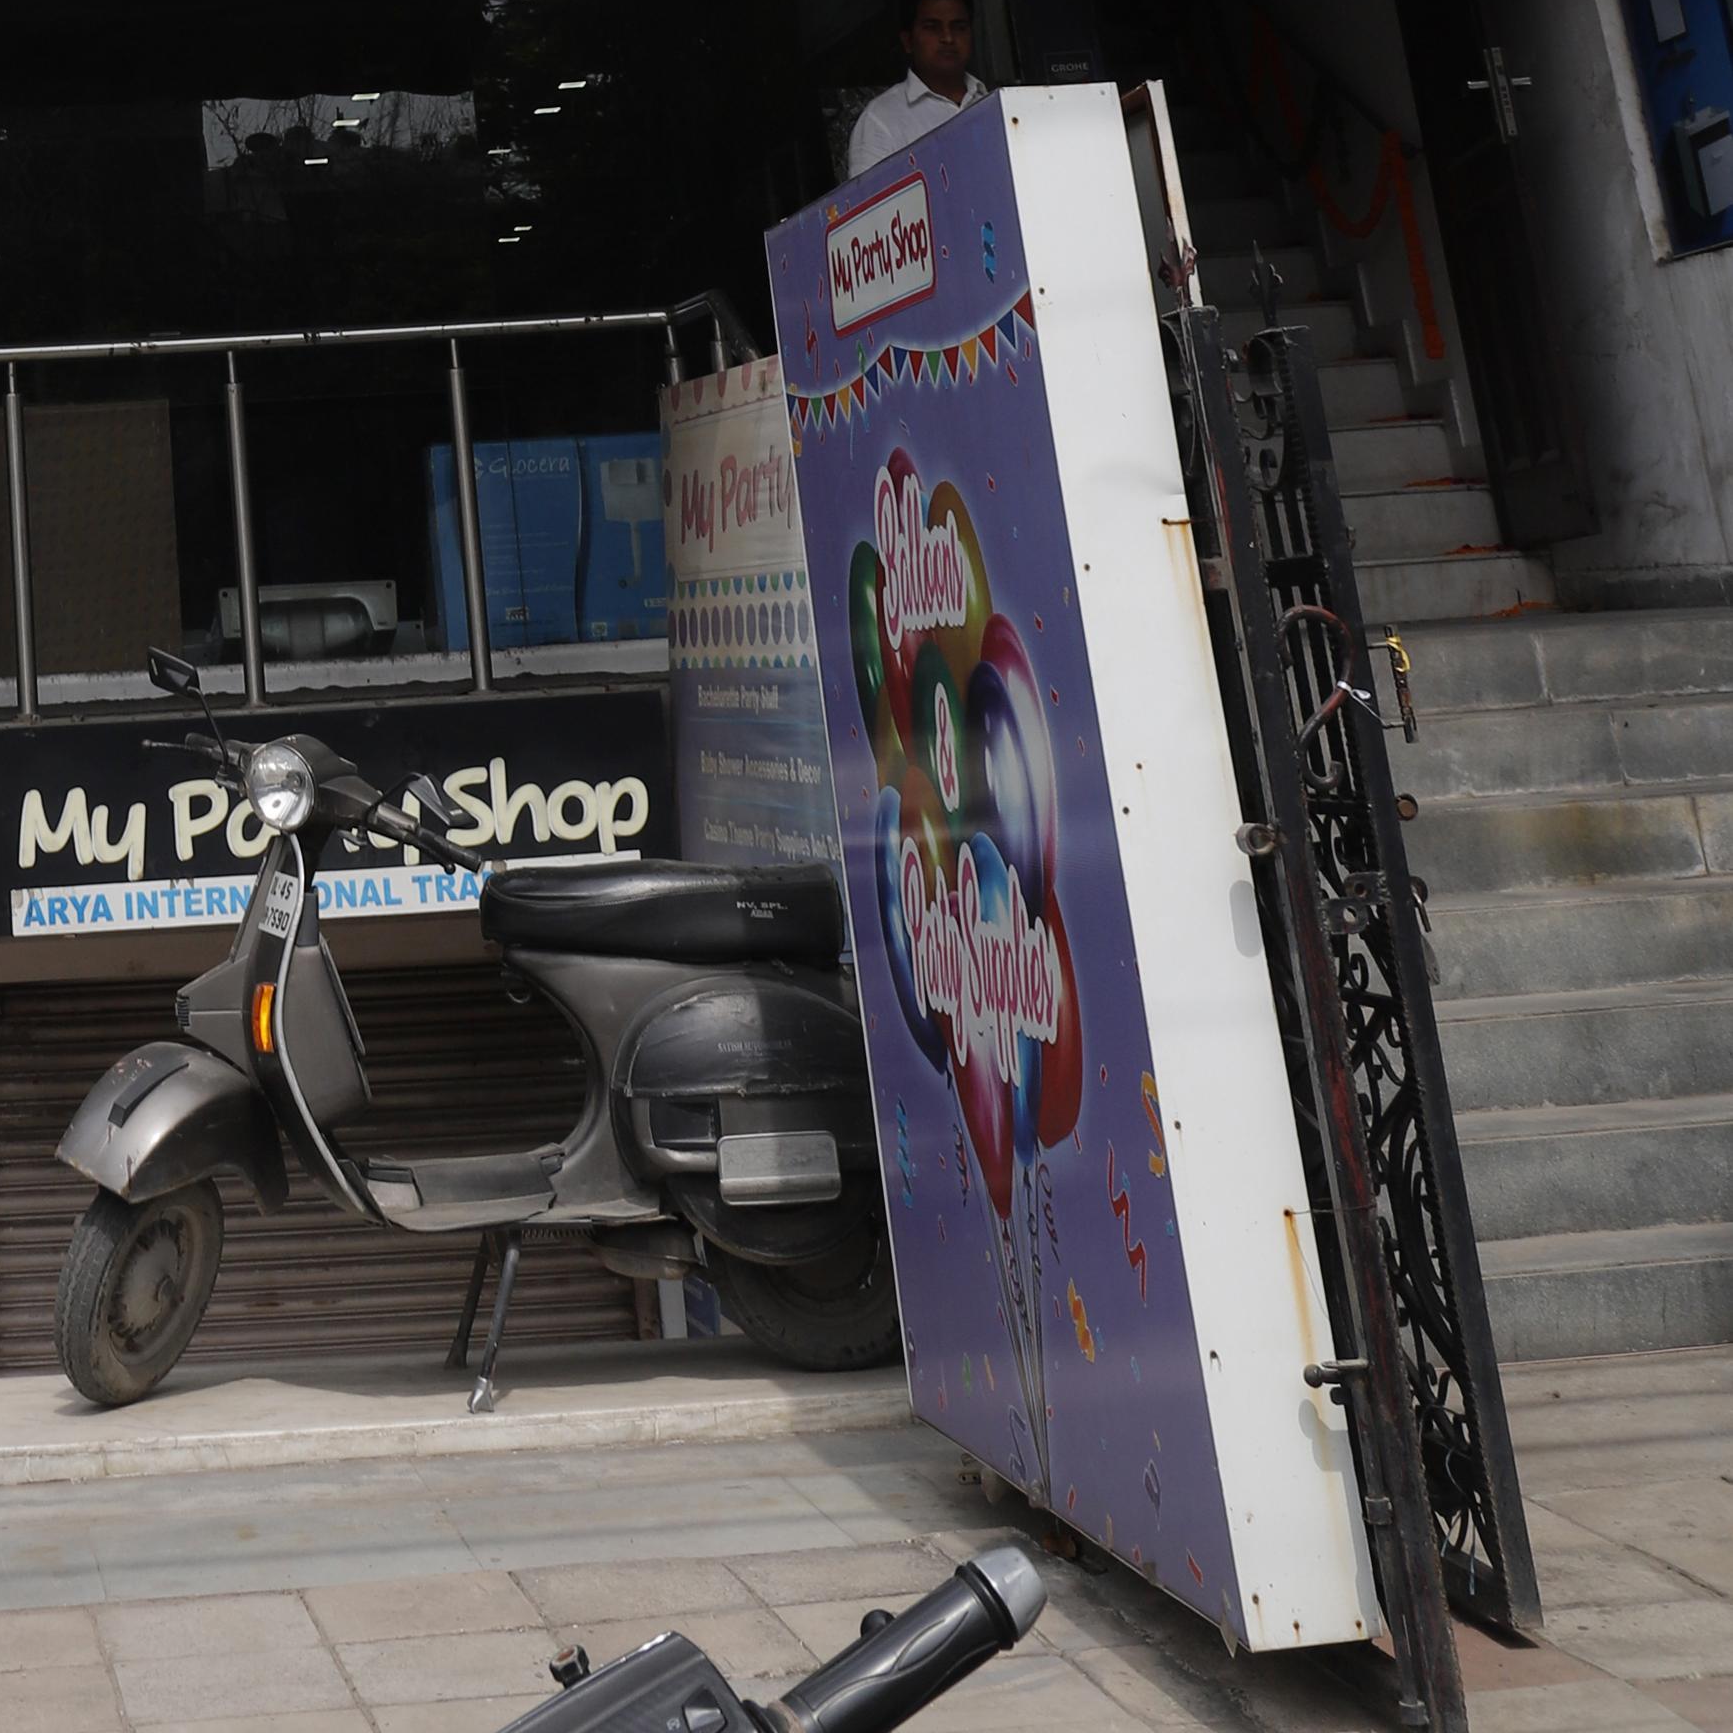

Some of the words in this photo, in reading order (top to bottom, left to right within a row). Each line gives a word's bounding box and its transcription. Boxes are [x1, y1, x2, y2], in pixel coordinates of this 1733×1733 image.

[1051, 61, 1089, 73] GROHE
[831, 247, 853, 299] My
[853, 227, 892, 291] Party
[891, 210, 928, 275] Shop
[681, 469, 714, 553] My
[720, 444, 794, 530] Party
[874, 466, 967, 651] Balloons
[19, 786, 146, 881] My
[443, 757, 649, 855] Shop
[24, 897, 113, 928] ARYA
[125, 878, 403, 920] INTERNONAL
[900, 837, 969, 1068] Party
[958, 841, 1060, 1086] Supplies
